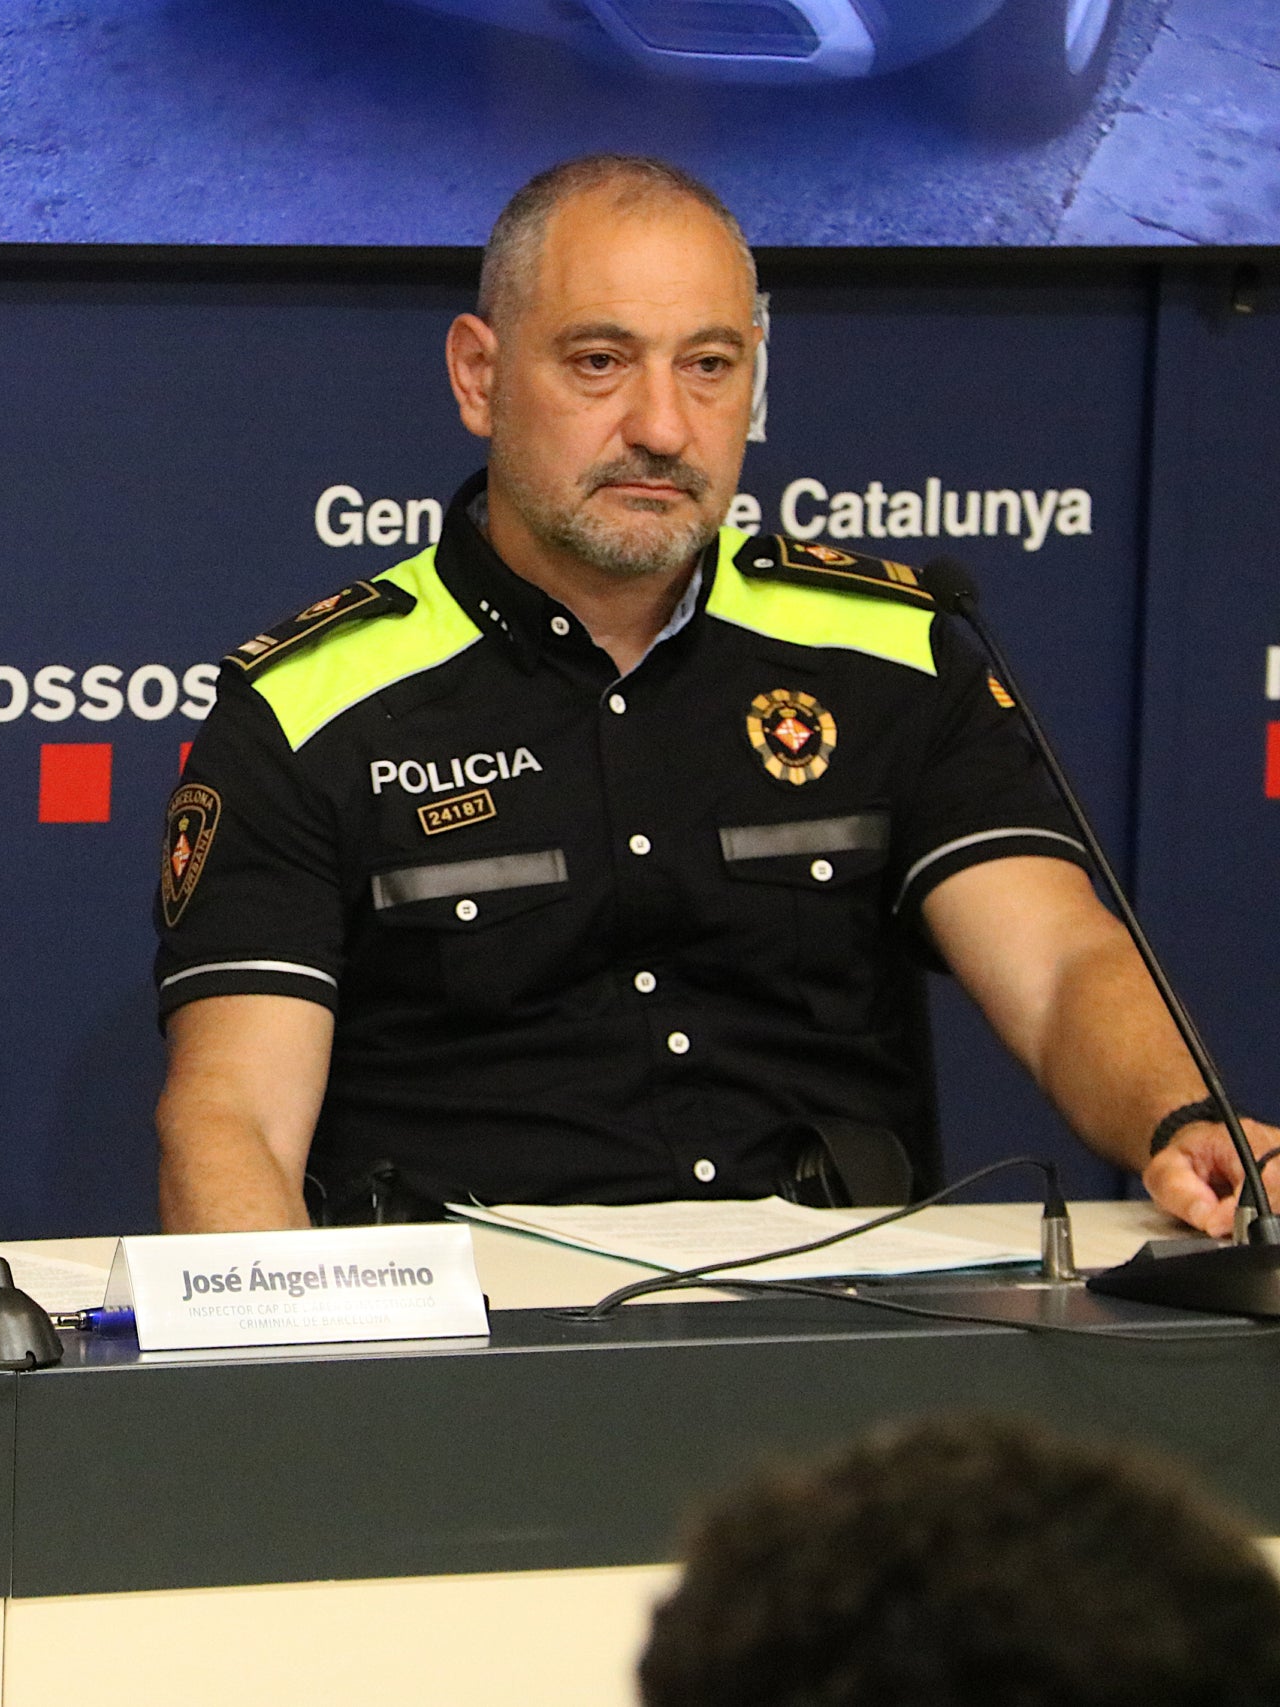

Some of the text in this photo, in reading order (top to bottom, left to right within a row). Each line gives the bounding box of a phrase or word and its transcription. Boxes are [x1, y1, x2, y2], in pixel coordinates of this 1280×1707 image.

[725, 477, 1092, 552] e Catalunya
[370, 746, 543, 795] POLICIA
[428, 798, 485, 826] 24187
[182, 1260, 434, 1301] José Ángel Merino
[188, 1304, 253, 1318] INSPECTOR
[257, 1303, 279, 1316] CAP
